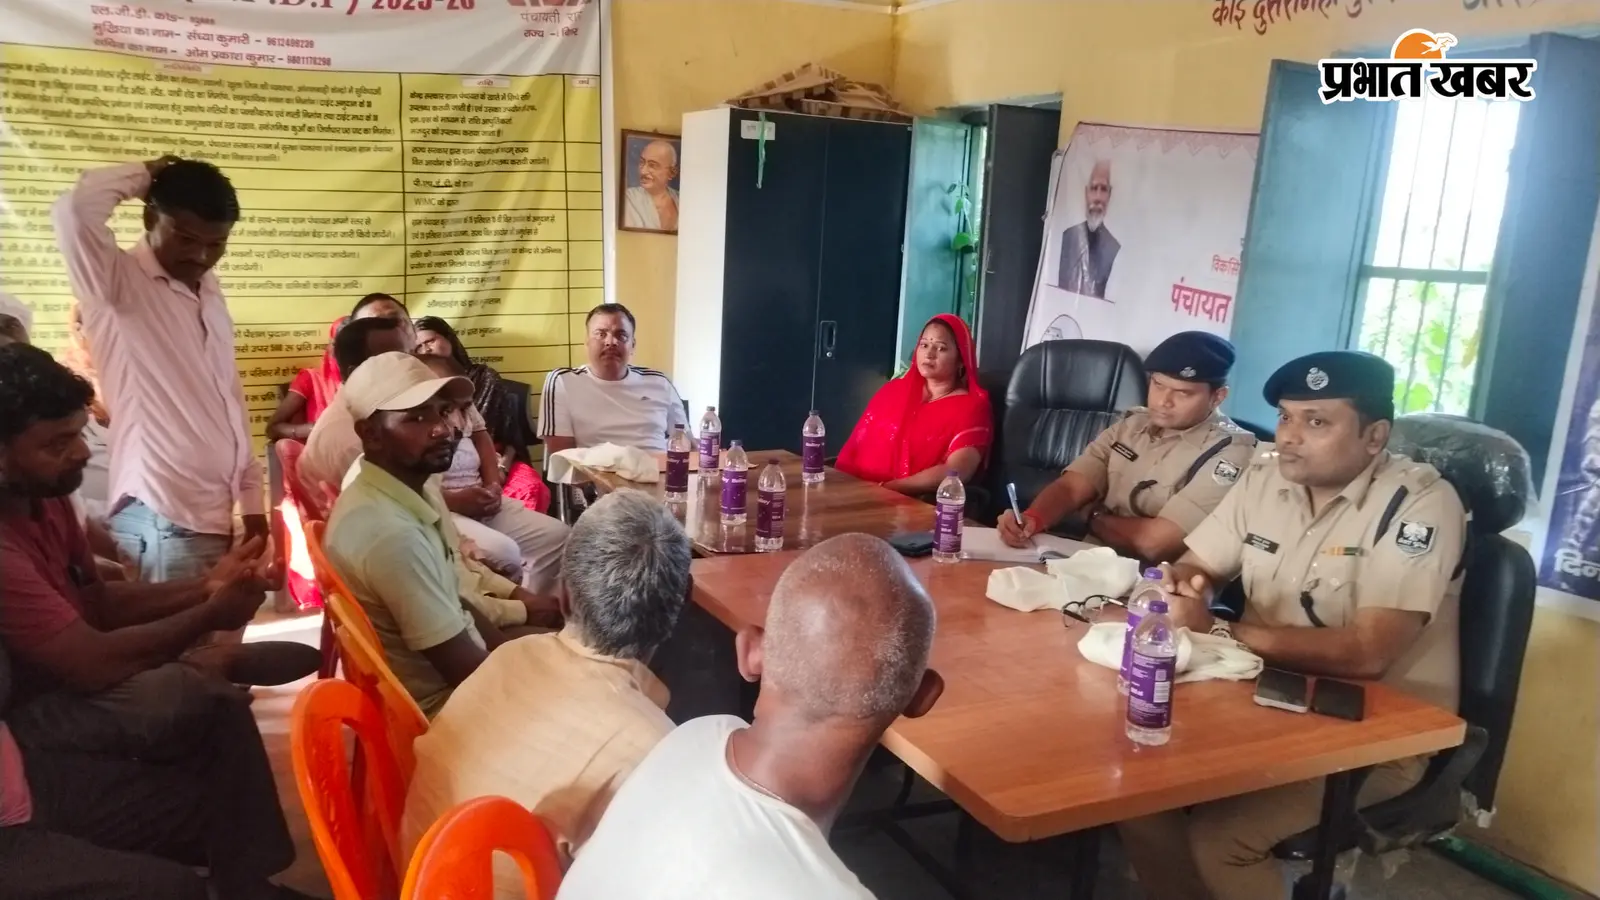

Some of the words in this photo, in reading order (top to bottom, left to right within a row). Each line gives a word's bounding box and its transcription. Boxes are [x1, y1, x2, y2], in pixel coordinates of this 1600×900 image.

[134, 26, 150, 37] का
[217, 33, 250, 50] कुमारी
[524, 28, 545, 38] राज्य
[245, 53, 276, 68] कुमार
[1171, 276, 1232, 324] पंचायत
